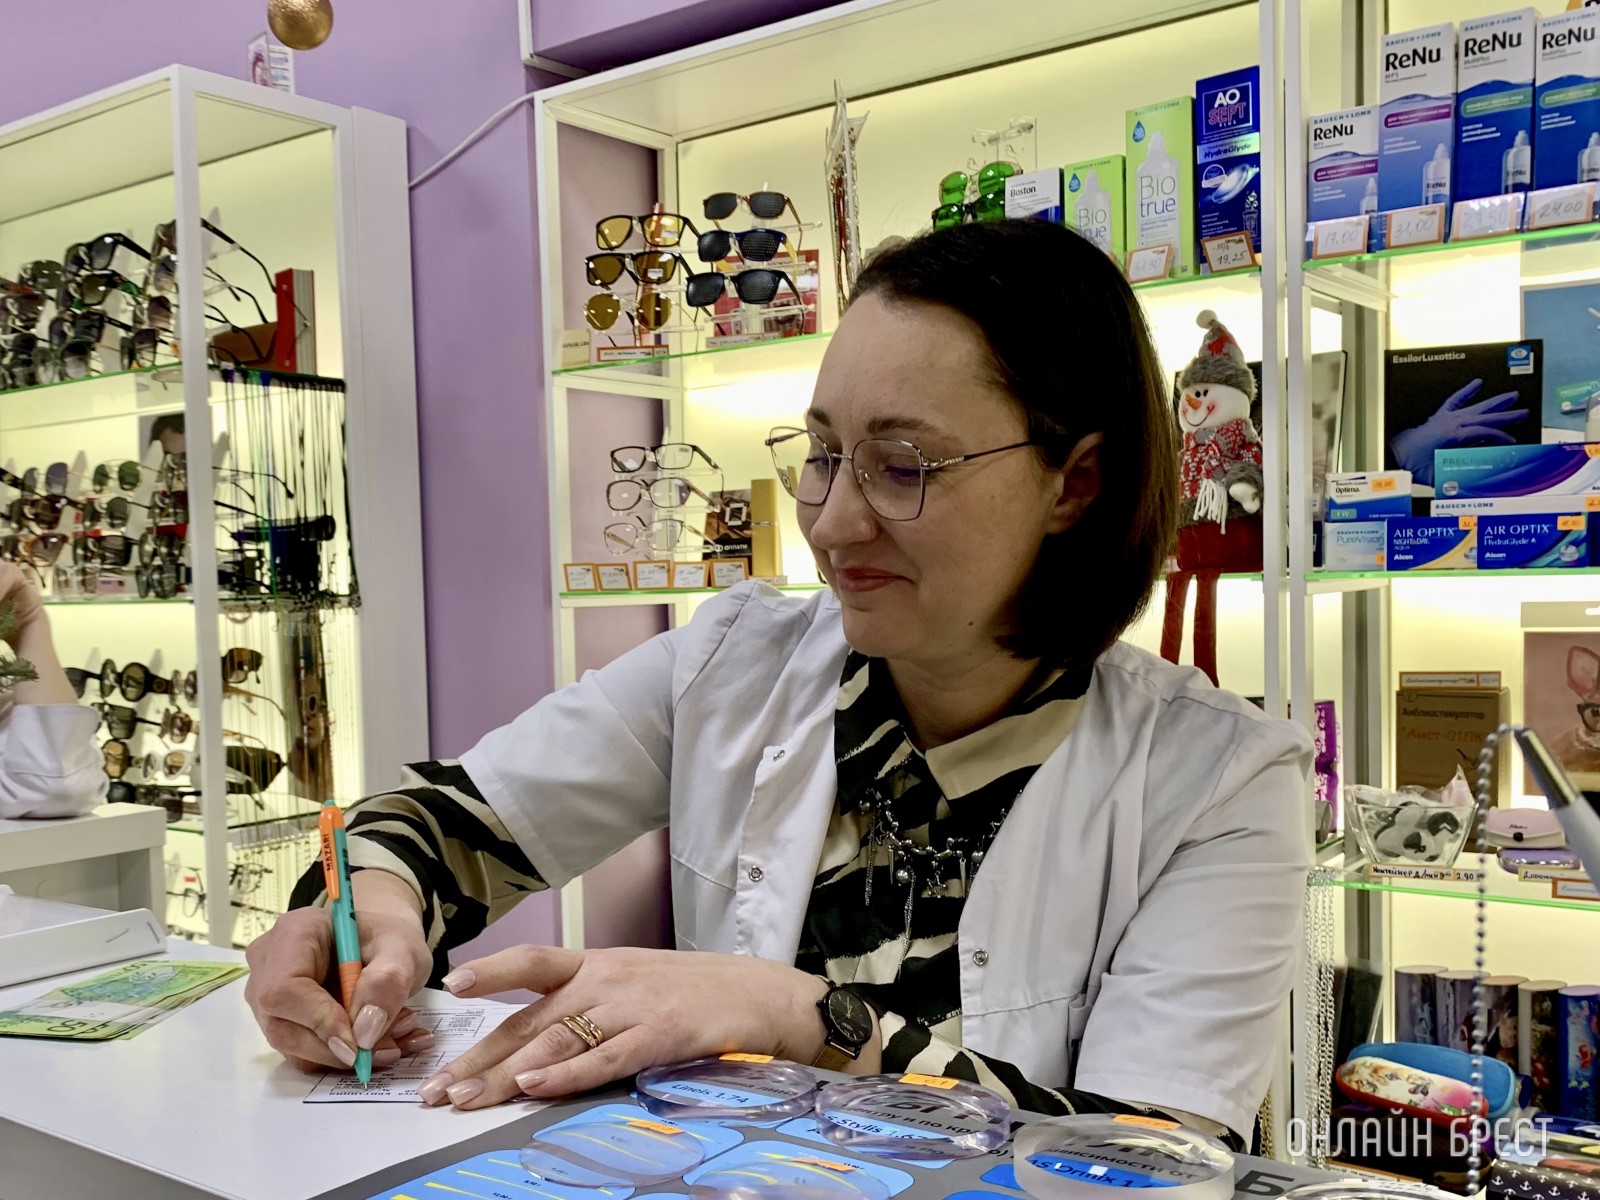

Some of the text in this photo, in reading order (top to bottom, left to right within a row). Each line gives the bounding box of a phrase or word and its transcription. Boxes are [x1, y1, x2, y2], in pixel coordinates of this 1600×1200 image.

[1464, 31, 1522, 57] ReNu
[1542, 26, 1595, 50] ReNu
[1385, 46, 1441, 72] ReNu
[1214, 88, 1241, 108] AO
[1208, 101, 1247, 125] SEPT
[1313, 123, 1354, 141] ReNu
[1010, 185, 1037, 198] Boston
[1139, 197, 1176, 218] true
[1083, 225, 1107, 238] rue
[1393, 351, 1466, 364] EssilorLuxottica
[1393, 527, 1455, 538] AIR OPTIX
[1484, 524, 1549, 535] AIR OPTIX
[322, 833, 334, 871] MAZARI
[671, 1083, 749, 1104] Lineis 1.74
[838, 1117, 883, 1134] Stylis
